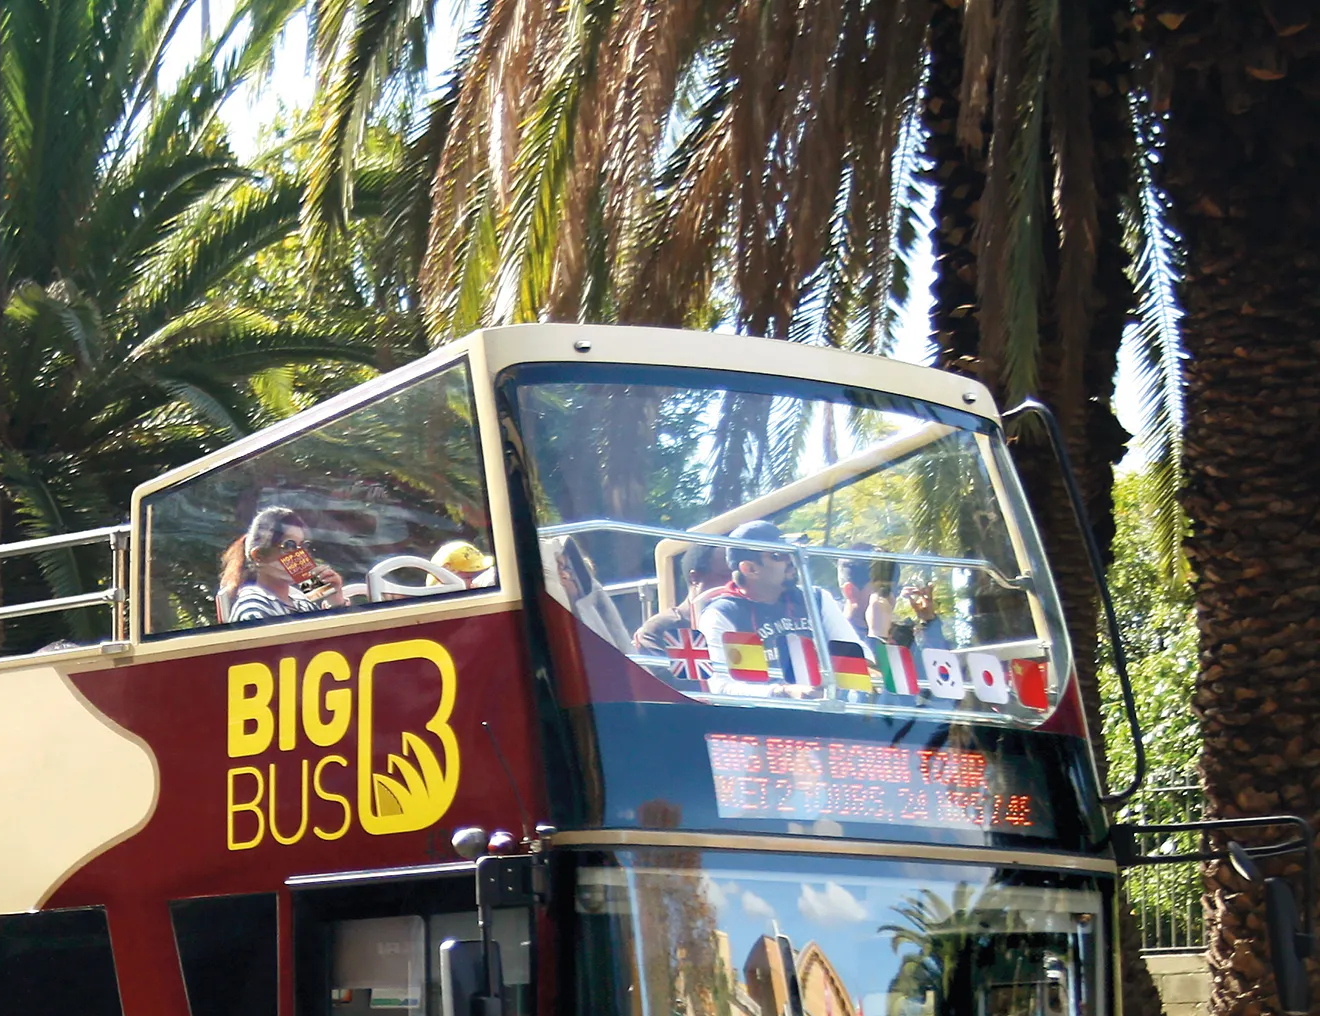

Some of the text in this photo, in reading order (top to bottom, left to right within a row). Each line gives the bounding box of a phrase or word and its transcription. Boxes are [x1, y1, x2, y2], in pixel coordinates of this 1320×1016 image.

[758, 623, 774, 641] OS
[228, 650, 352, 758] BIG
[228, 755, 352, 850] BUS
